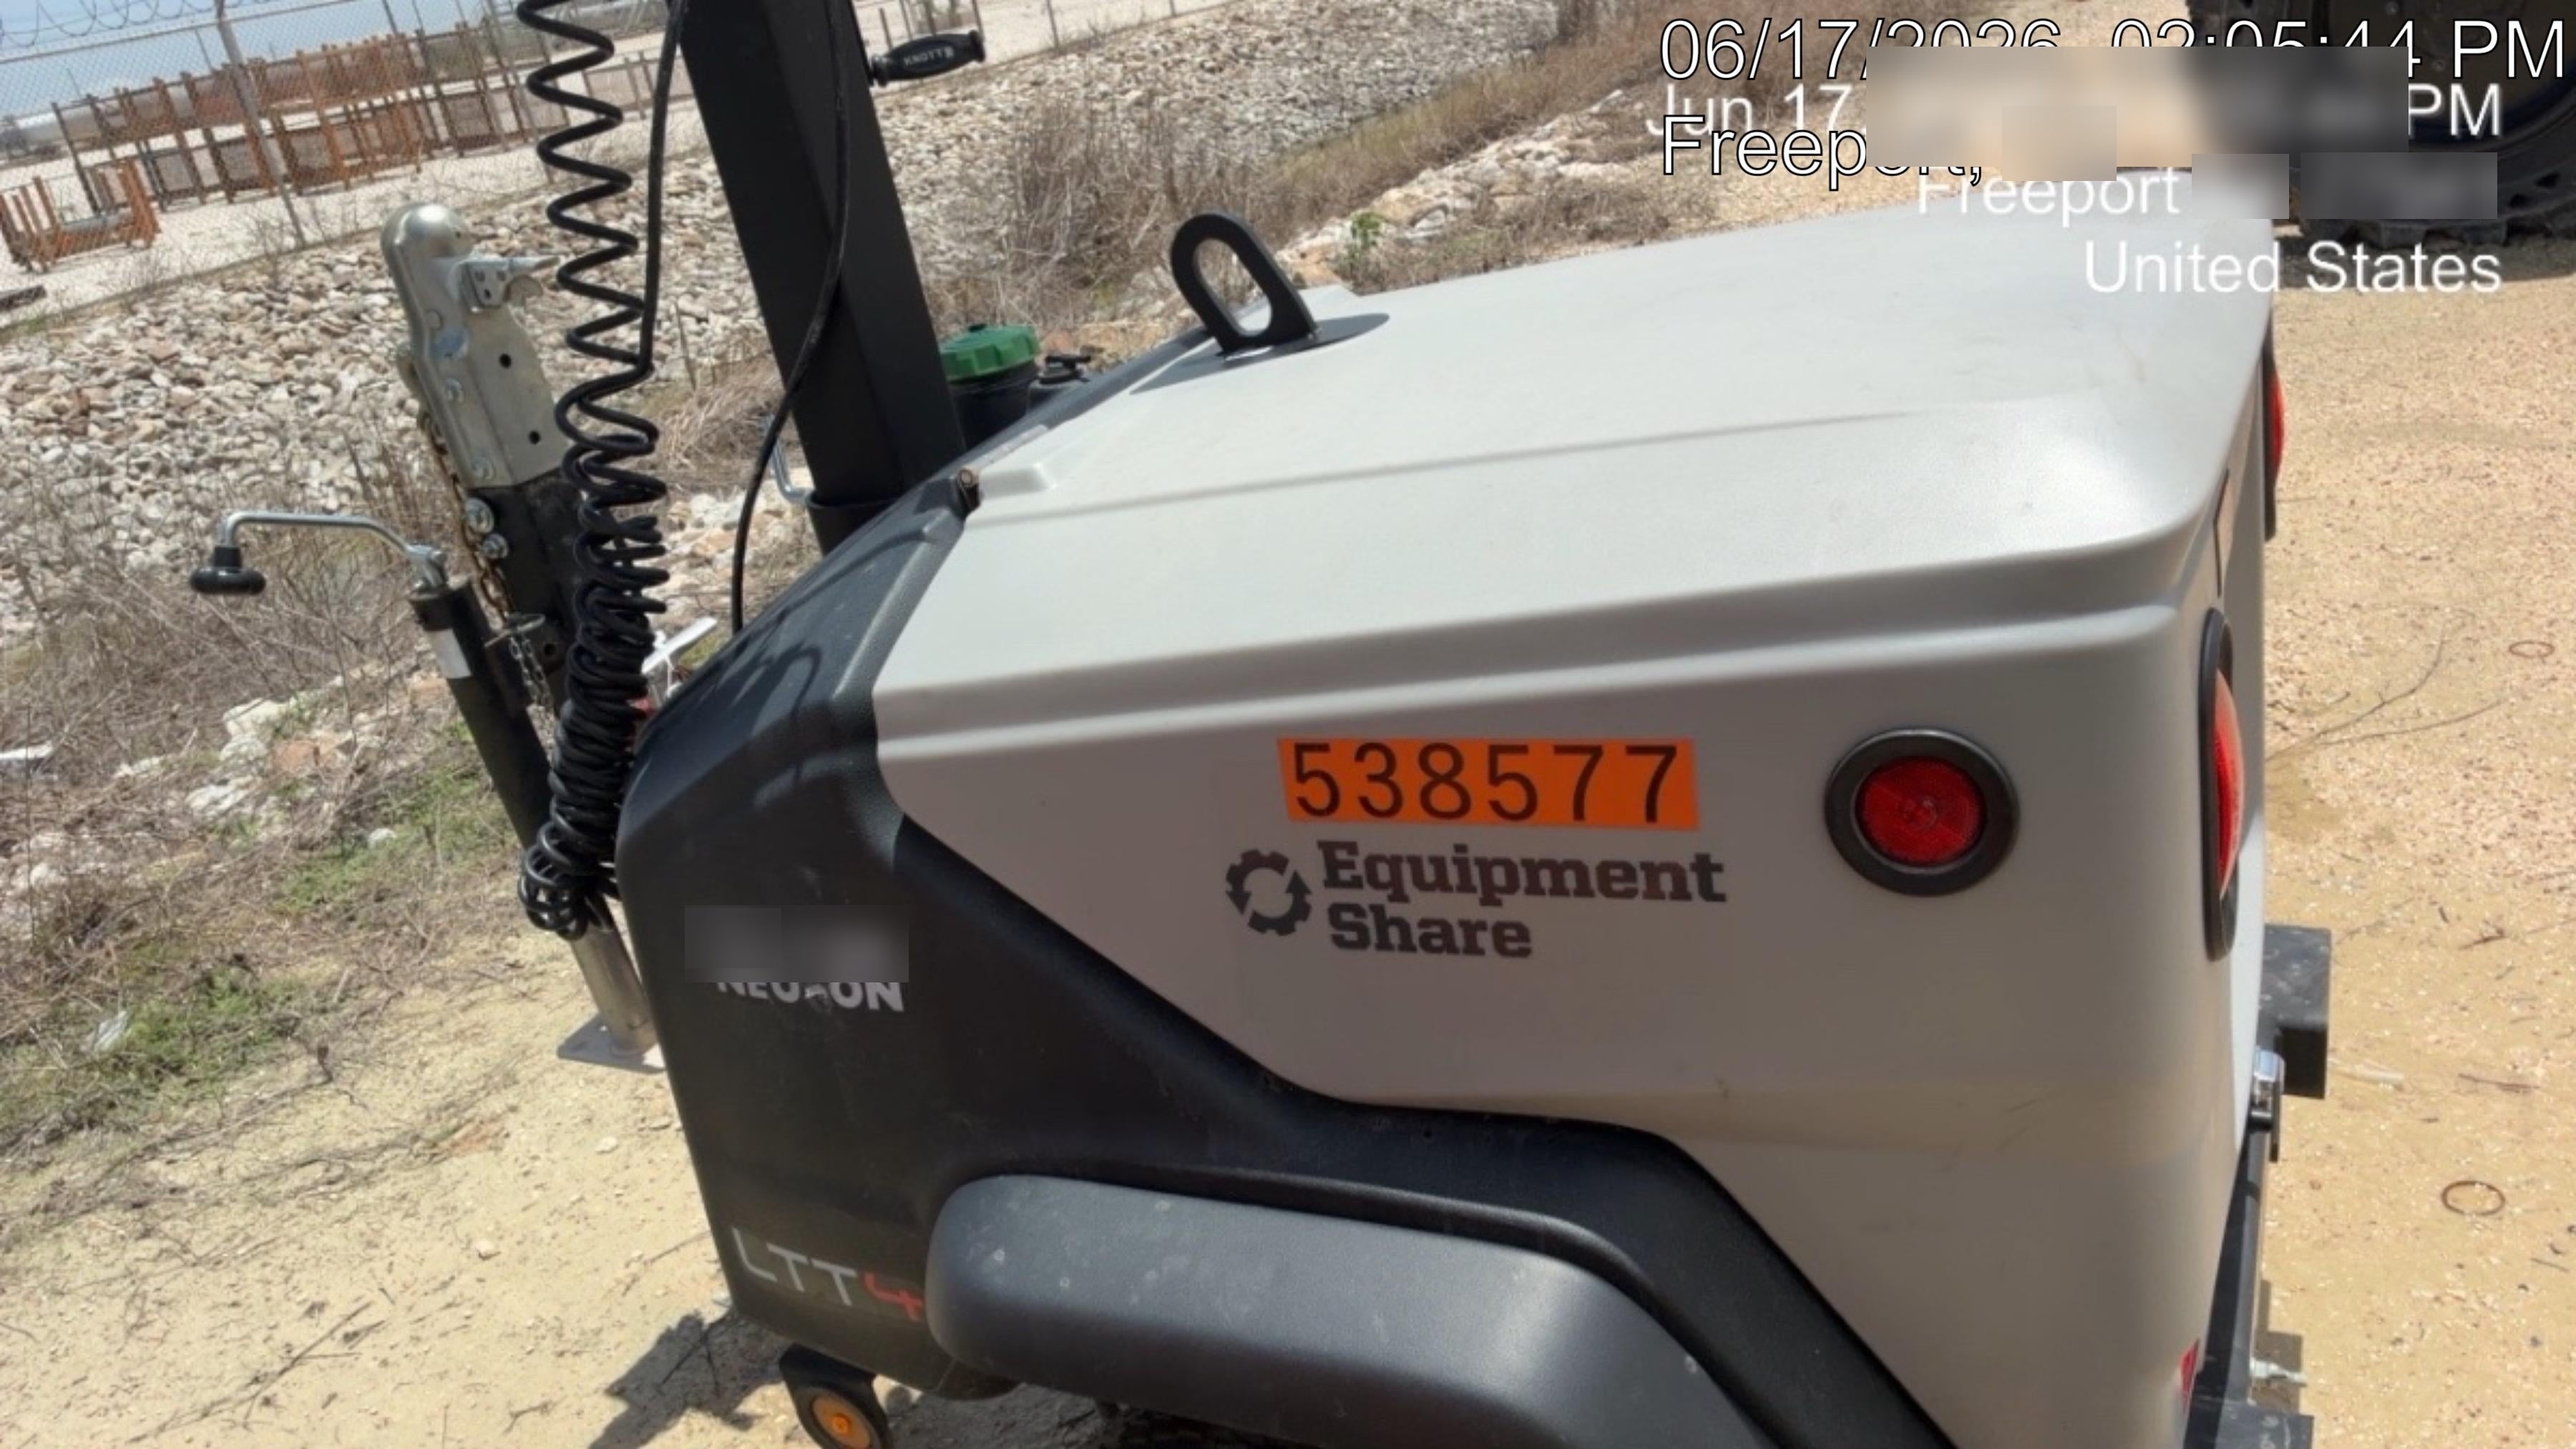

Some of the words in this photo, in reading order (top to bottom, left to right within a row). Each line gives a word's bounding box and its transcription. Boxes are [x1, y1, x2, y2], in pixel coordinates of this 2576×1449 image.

[1293, 742, 1677, 823] 538577
[1317, 840, 1727, 907] Equipment
[1327, 902, 1532, 958] Share
